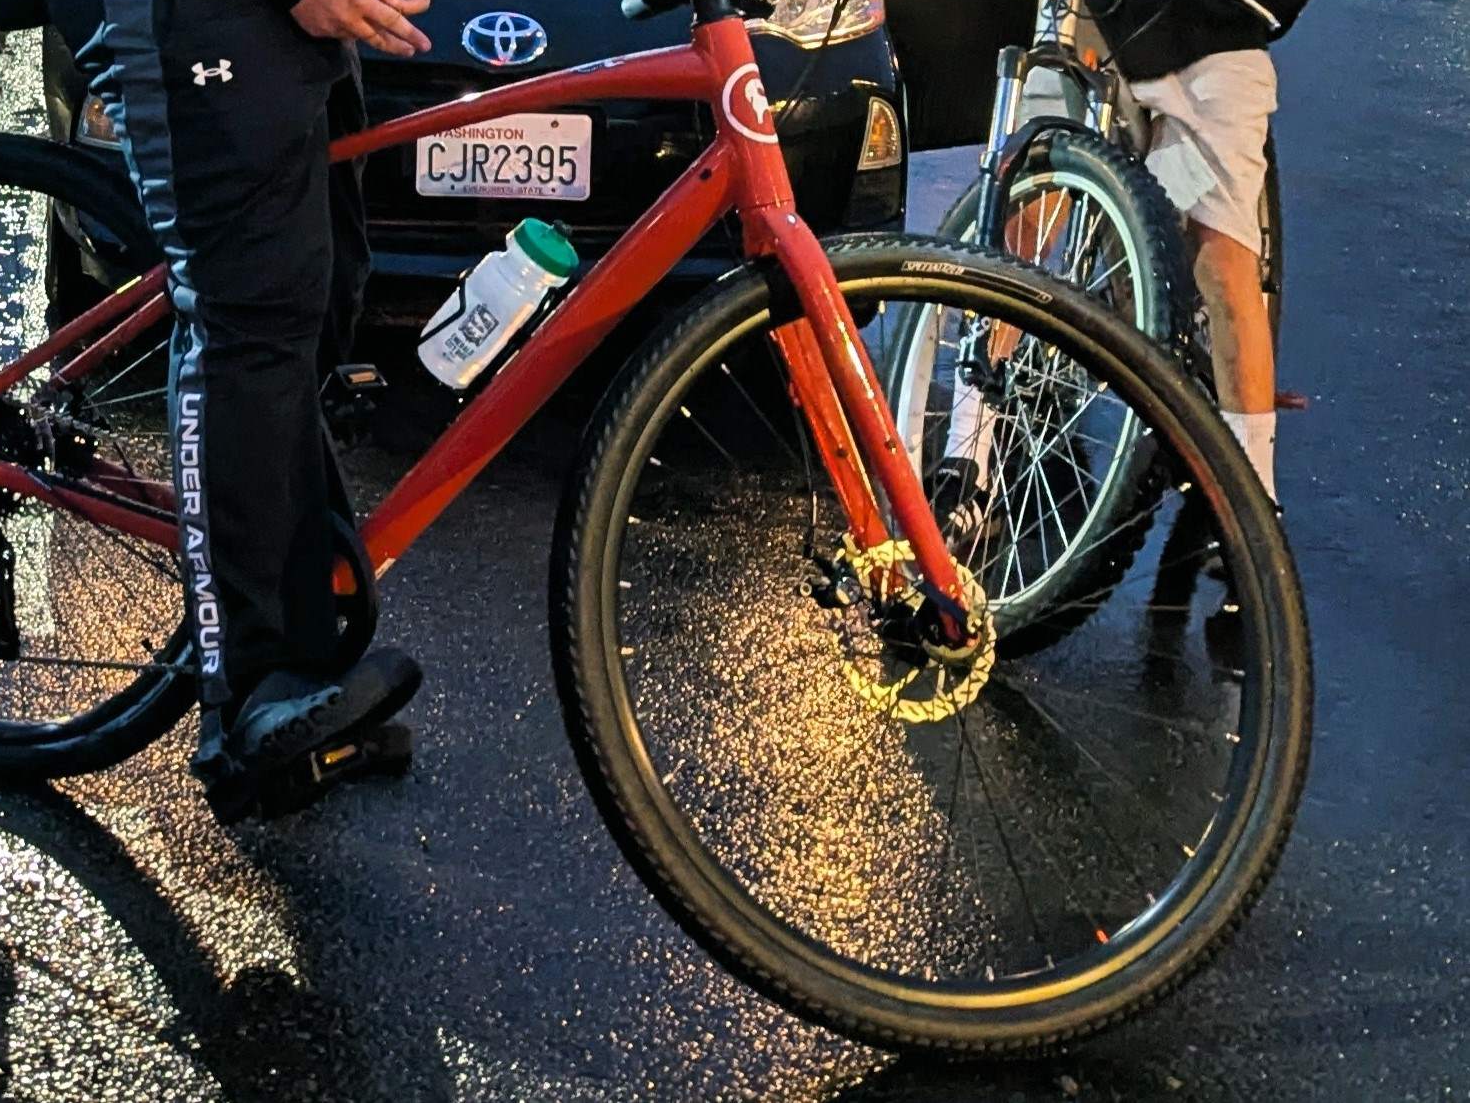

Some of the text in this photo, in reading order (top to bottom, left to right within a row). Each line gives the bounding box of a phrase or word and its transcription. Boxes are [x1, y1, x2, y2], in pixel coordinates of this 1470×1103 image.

[428, 142, 578, 186] CJR2395
[180, 393, 202, 516] UNDER
[185, 524, 221, 675] ARMOUR
